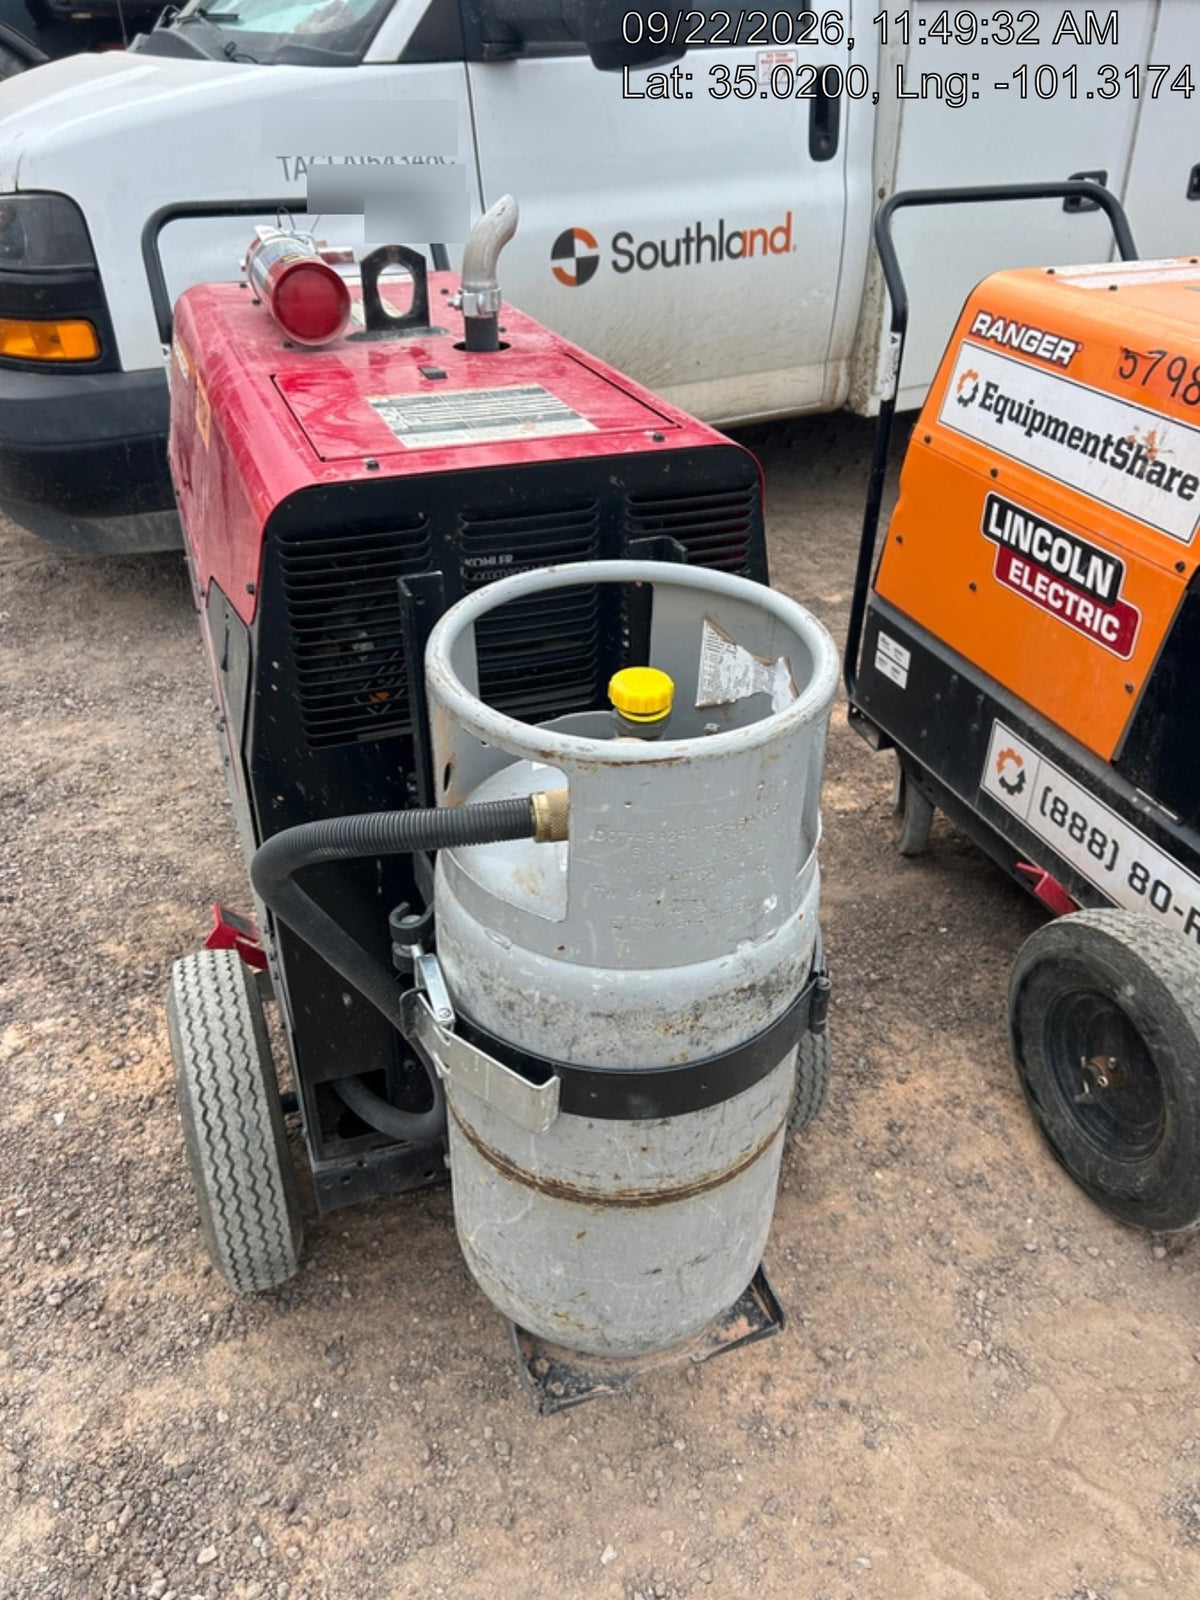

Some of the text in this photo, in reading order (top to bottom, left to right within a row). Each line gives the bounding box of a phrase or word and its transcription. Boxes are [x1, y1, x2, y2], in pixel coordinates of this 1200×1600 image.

[611, 211, 792, 274] Southland
[971, 311, 1077, 366] RANGER
[978, 380, 1200, 501] EquipmentShare
[988, 502, 1115, 598] LINCOLN
[1008, 557, 1121, 642] ELECTRIC
[1039, 785, 1119, 872] (888)
